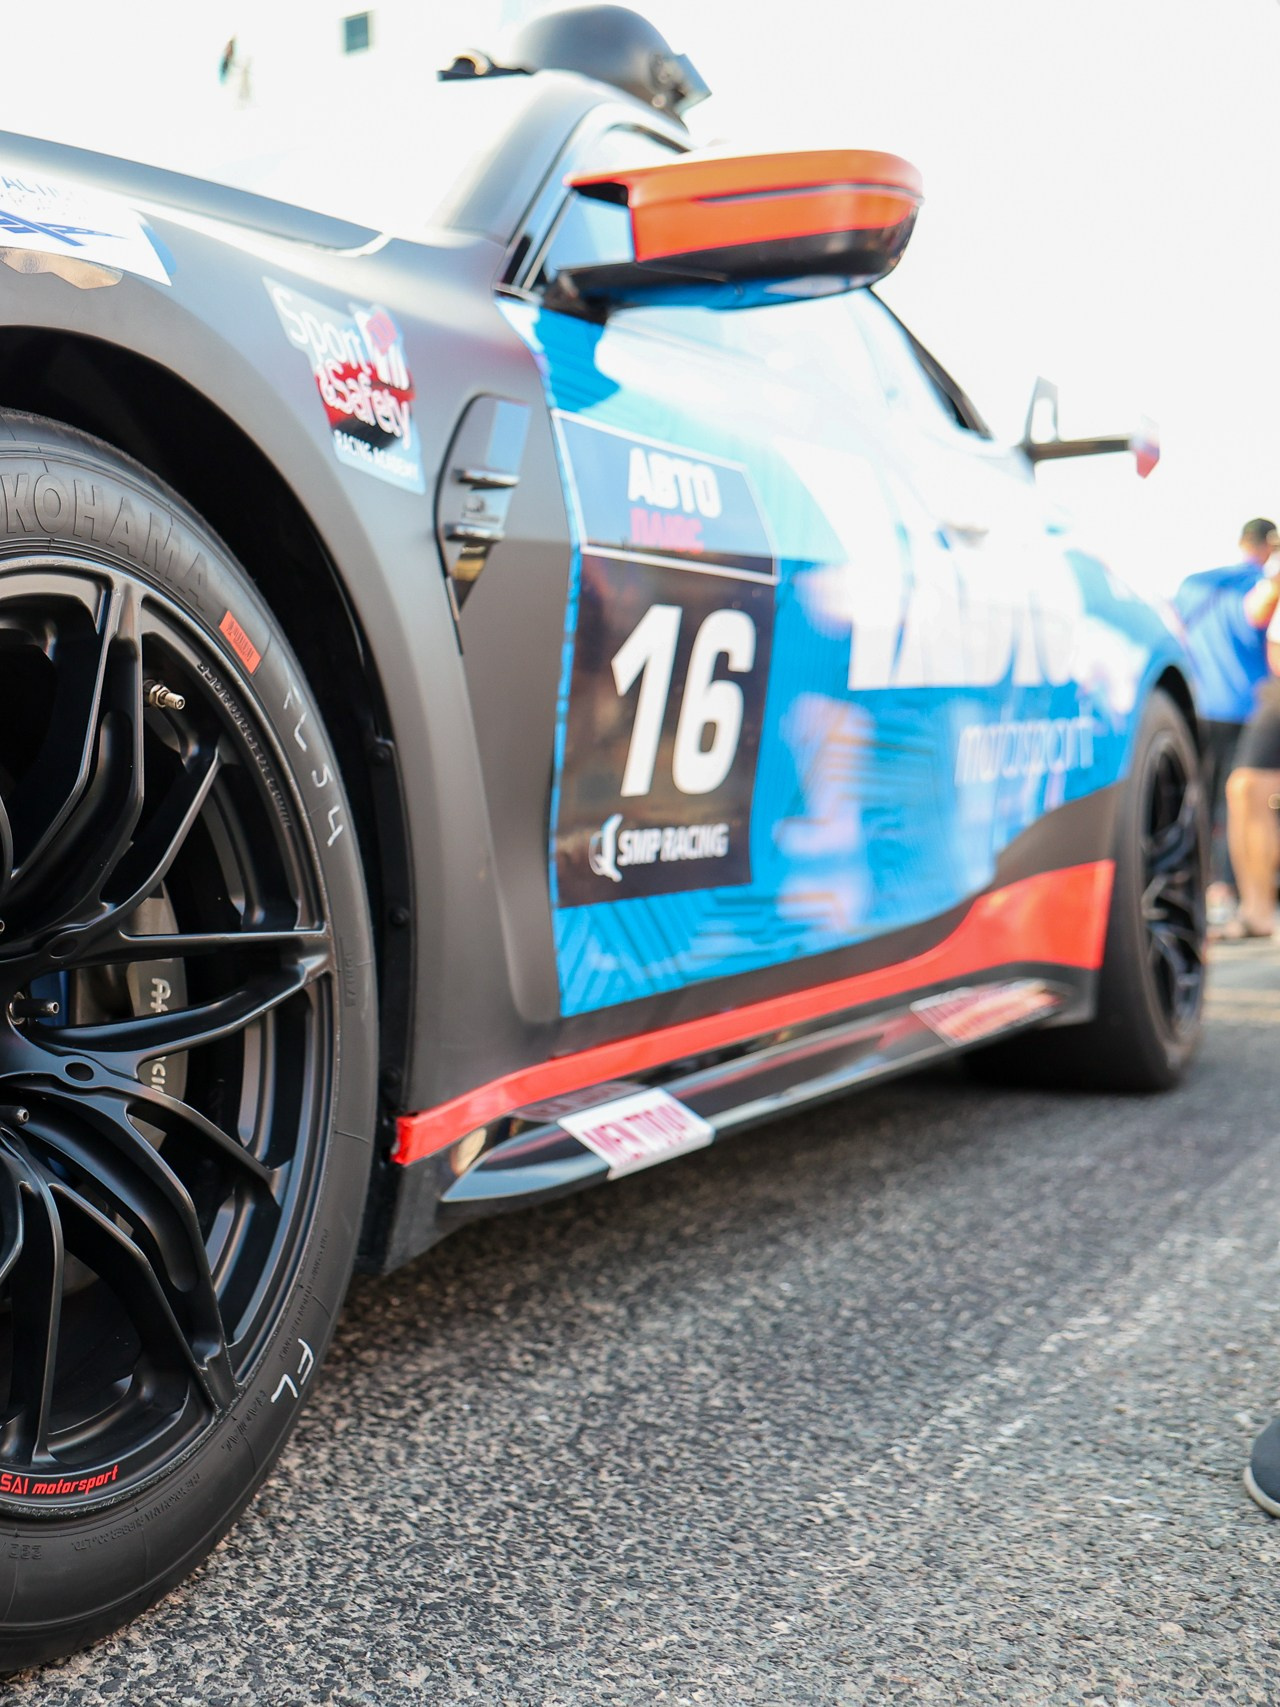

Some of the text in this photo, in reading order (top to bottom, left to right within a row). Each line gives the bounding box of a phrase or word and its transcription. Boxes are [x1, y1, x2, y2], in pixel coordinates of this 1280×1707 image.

[273, 287, 372, 375] Sport
[611, 603, 757, 797] 16
[617, 822, 730, 867] SMP RACING
[270, 1337, 315, 1404] FL
[0, 1464, 119, 1496] SAI motorsport
